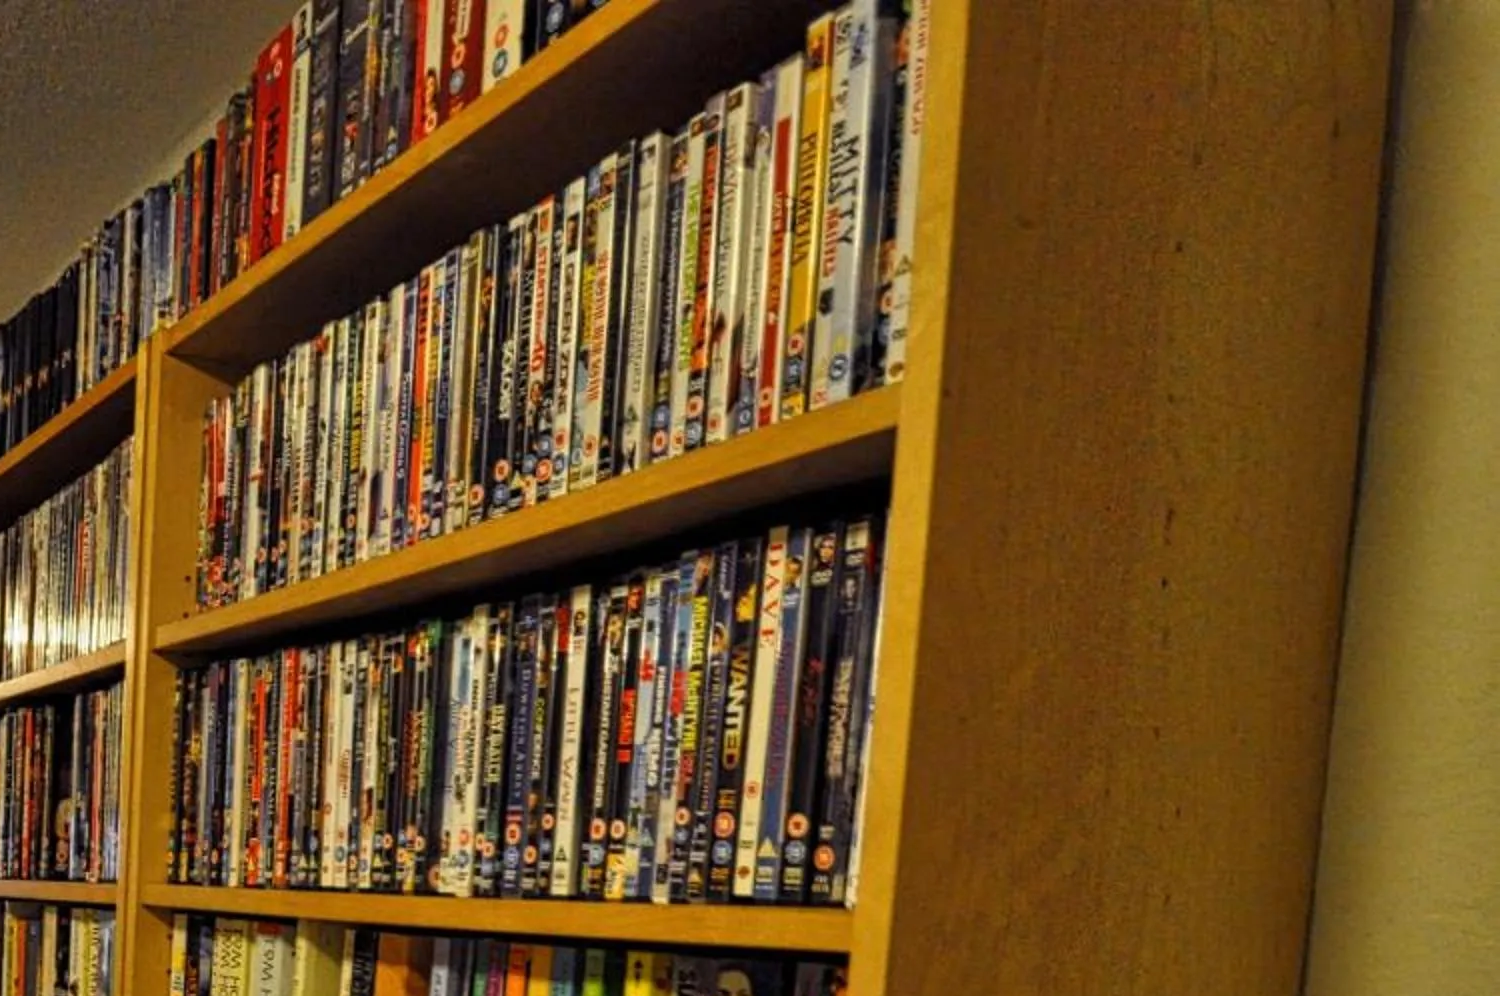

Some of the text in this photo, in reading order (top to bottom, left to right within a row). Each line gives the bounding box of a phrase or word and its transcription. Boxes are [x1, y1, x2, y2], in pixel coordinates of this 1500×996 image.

[837, 135, 860, 246] MITTY
[557, 263, 574, 415] GREEN ZONE
[760, 542, 784, 650] DAVE
[517, 668, 532, 746] DOWNTON
[683, 596, 708, 751] MICHAEL McINTYRE
[723, 644, 751, 771] WANTED
[262, 937, 277, 982] TOM
